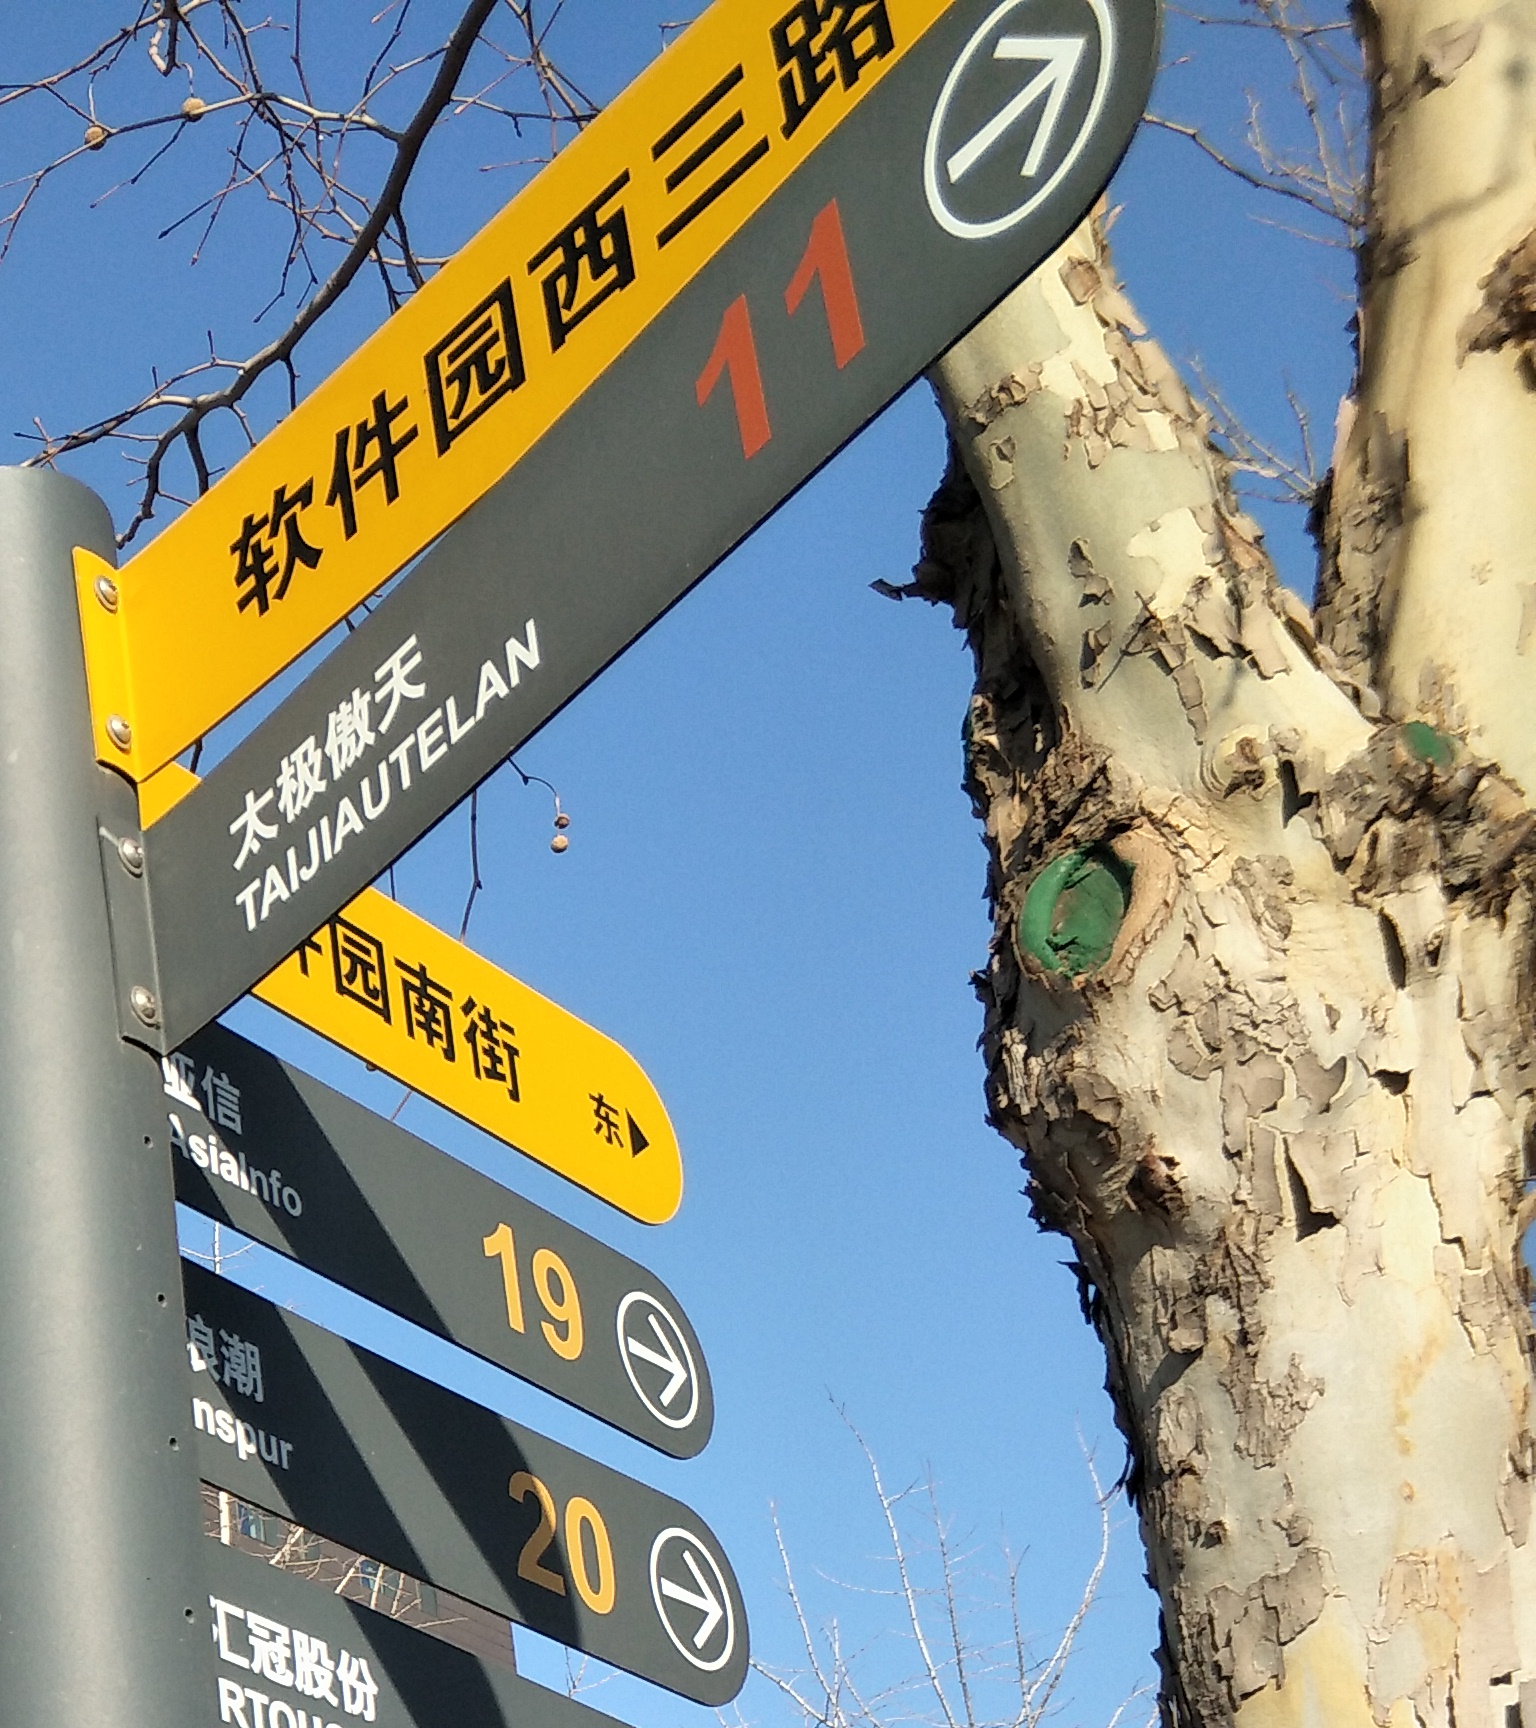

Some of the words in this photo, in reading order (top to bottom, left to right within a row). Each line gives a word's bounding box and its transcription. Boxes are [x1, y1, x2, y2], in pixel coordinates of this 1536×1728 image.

[229, 0, 896, 617] 软件园西三路
[694, 197, 865, 460] 11
[229, 634, 427, 869] 太极傲天
[234, 619, 542, 932] TAIJIAUTELAN
[588, 1093, 625, 1149] 东
[482, 1223, 584, 1360] 19
[192, 1397, 293, 1470] nspur
[508, 1471, 616, 1615] 20
[208, 1594, 379, 1722] 汇冠股份
